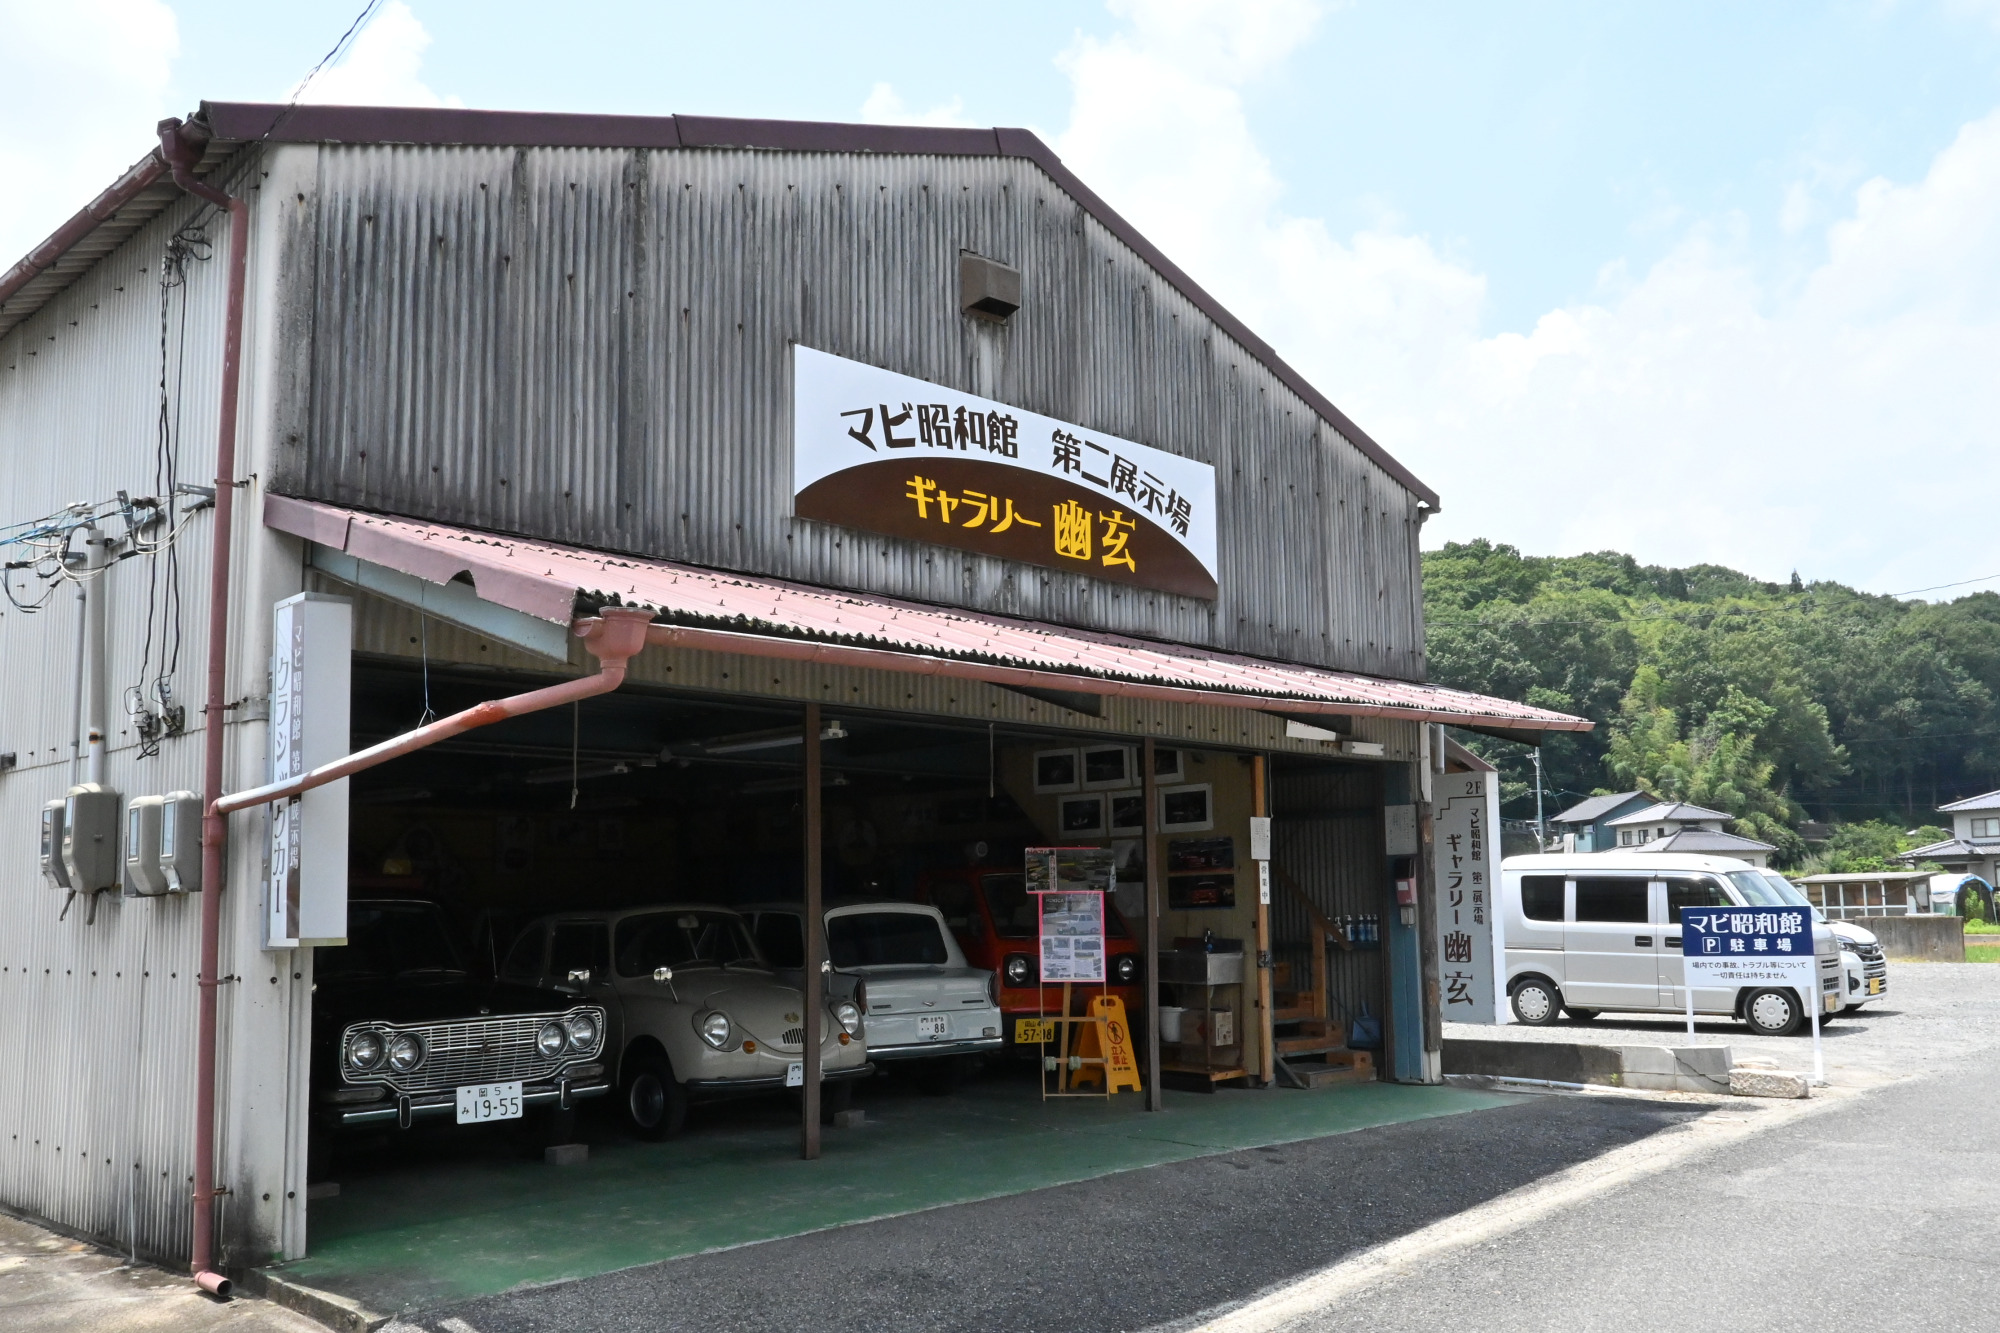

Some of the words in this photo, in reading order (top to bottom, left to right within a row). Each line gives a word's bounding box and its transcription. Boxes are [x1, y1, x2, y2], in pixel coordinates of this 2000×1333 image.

[840, 402, 1018, 459] マビ昭和館
[1051, 428, 1192, 538] 第二展示場
[905, 475, 1042, 533] ギャラリー
[1053, 499, 1136, 573] 幽玄
[292, 624, 303, 741] マビ昭和館
[1465, 781, 1482, 795] 2F
[289, 751, 302, 870] 第展示場
[1469, 808, 1482, 861] マビ昭和館
[1446, 833, 1463, 925] ギャラリー
[1472, 871, 1484, 925] 第二展示場
[1688, 912, 1803, 935] マビ昭和館
[1706, 939, 1716, 951] P
[1730, 938, 1792, 952] 駐車場
[1444, 930, 1474, 1006] 幽玄
[1692, 961, 1807, 969] 場内での事故、トラブル等について
[1712, 972, 1788, 980] 一切責任は持ちません
[1111, 1045, 1127, 1055] 立入
[475, 1097, 518, 1118] 19-55
[494, 1087, 501, 1096] 5
